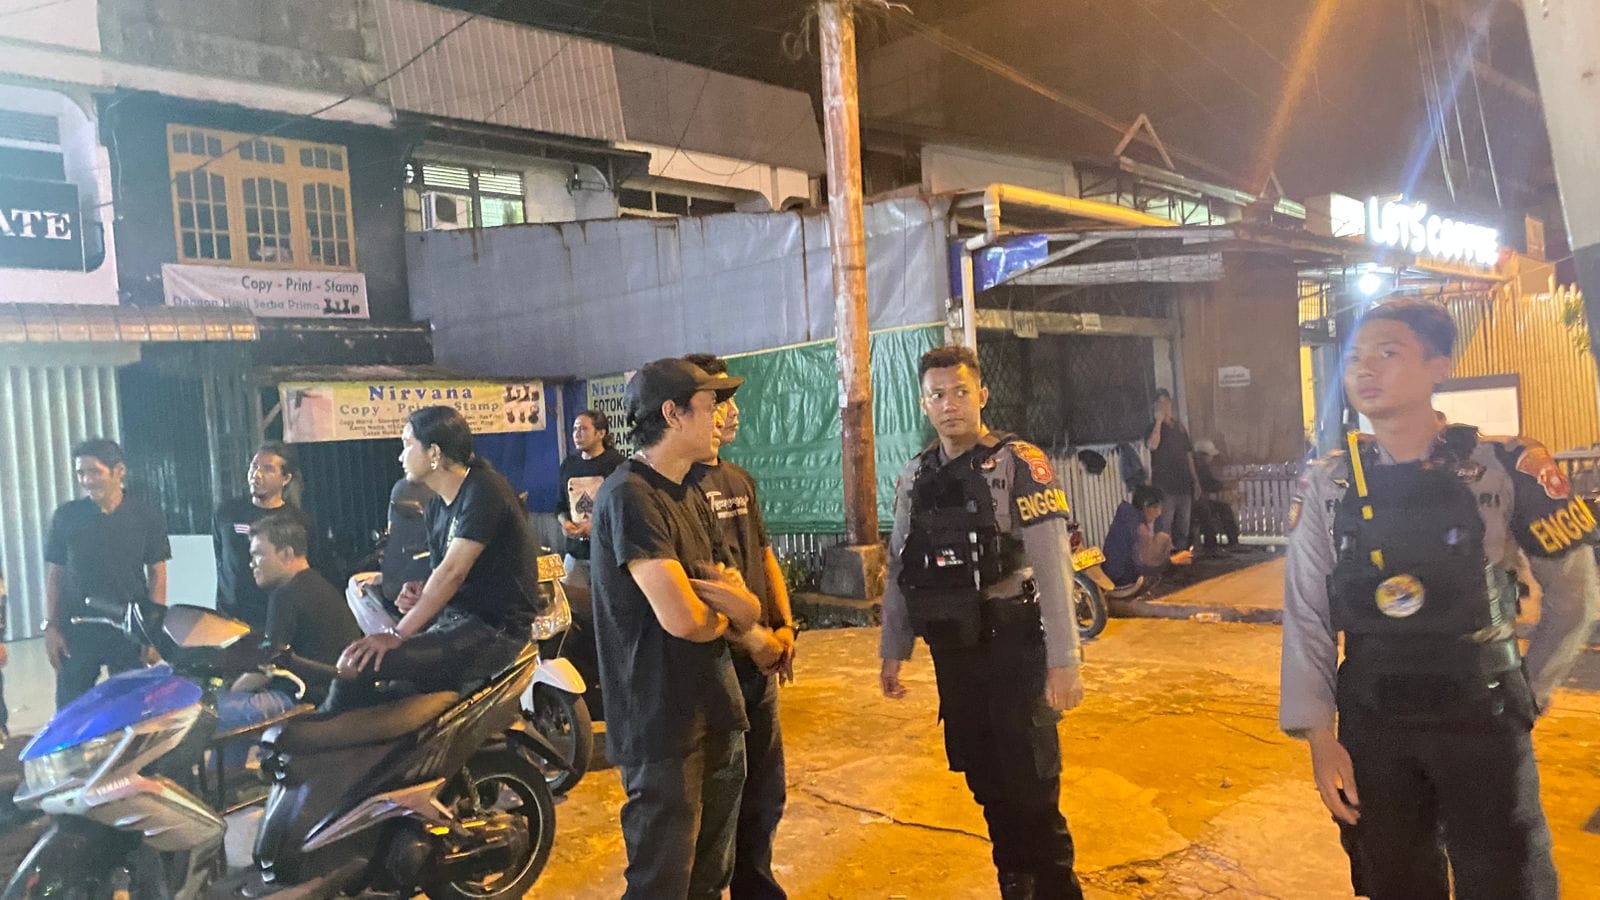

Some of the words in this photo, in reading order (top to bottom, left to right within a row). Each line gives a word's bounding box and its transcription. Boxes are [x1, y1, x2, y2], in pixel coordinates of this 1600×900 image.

[241, 275, 273, 293] Copy
[286, 277, 312, 293] Print
[324, 279, 359, 294] Stamp
[368, 384, 473, 402] Nirvana
[339, 404, 380, 417] Copy
[398, 402, 436, 413] Pri
[454, 401, 499, 412] Stamp
[593, 397, 626, 412] FOTOK
[95, 777, 131, 797] YAMAHA
